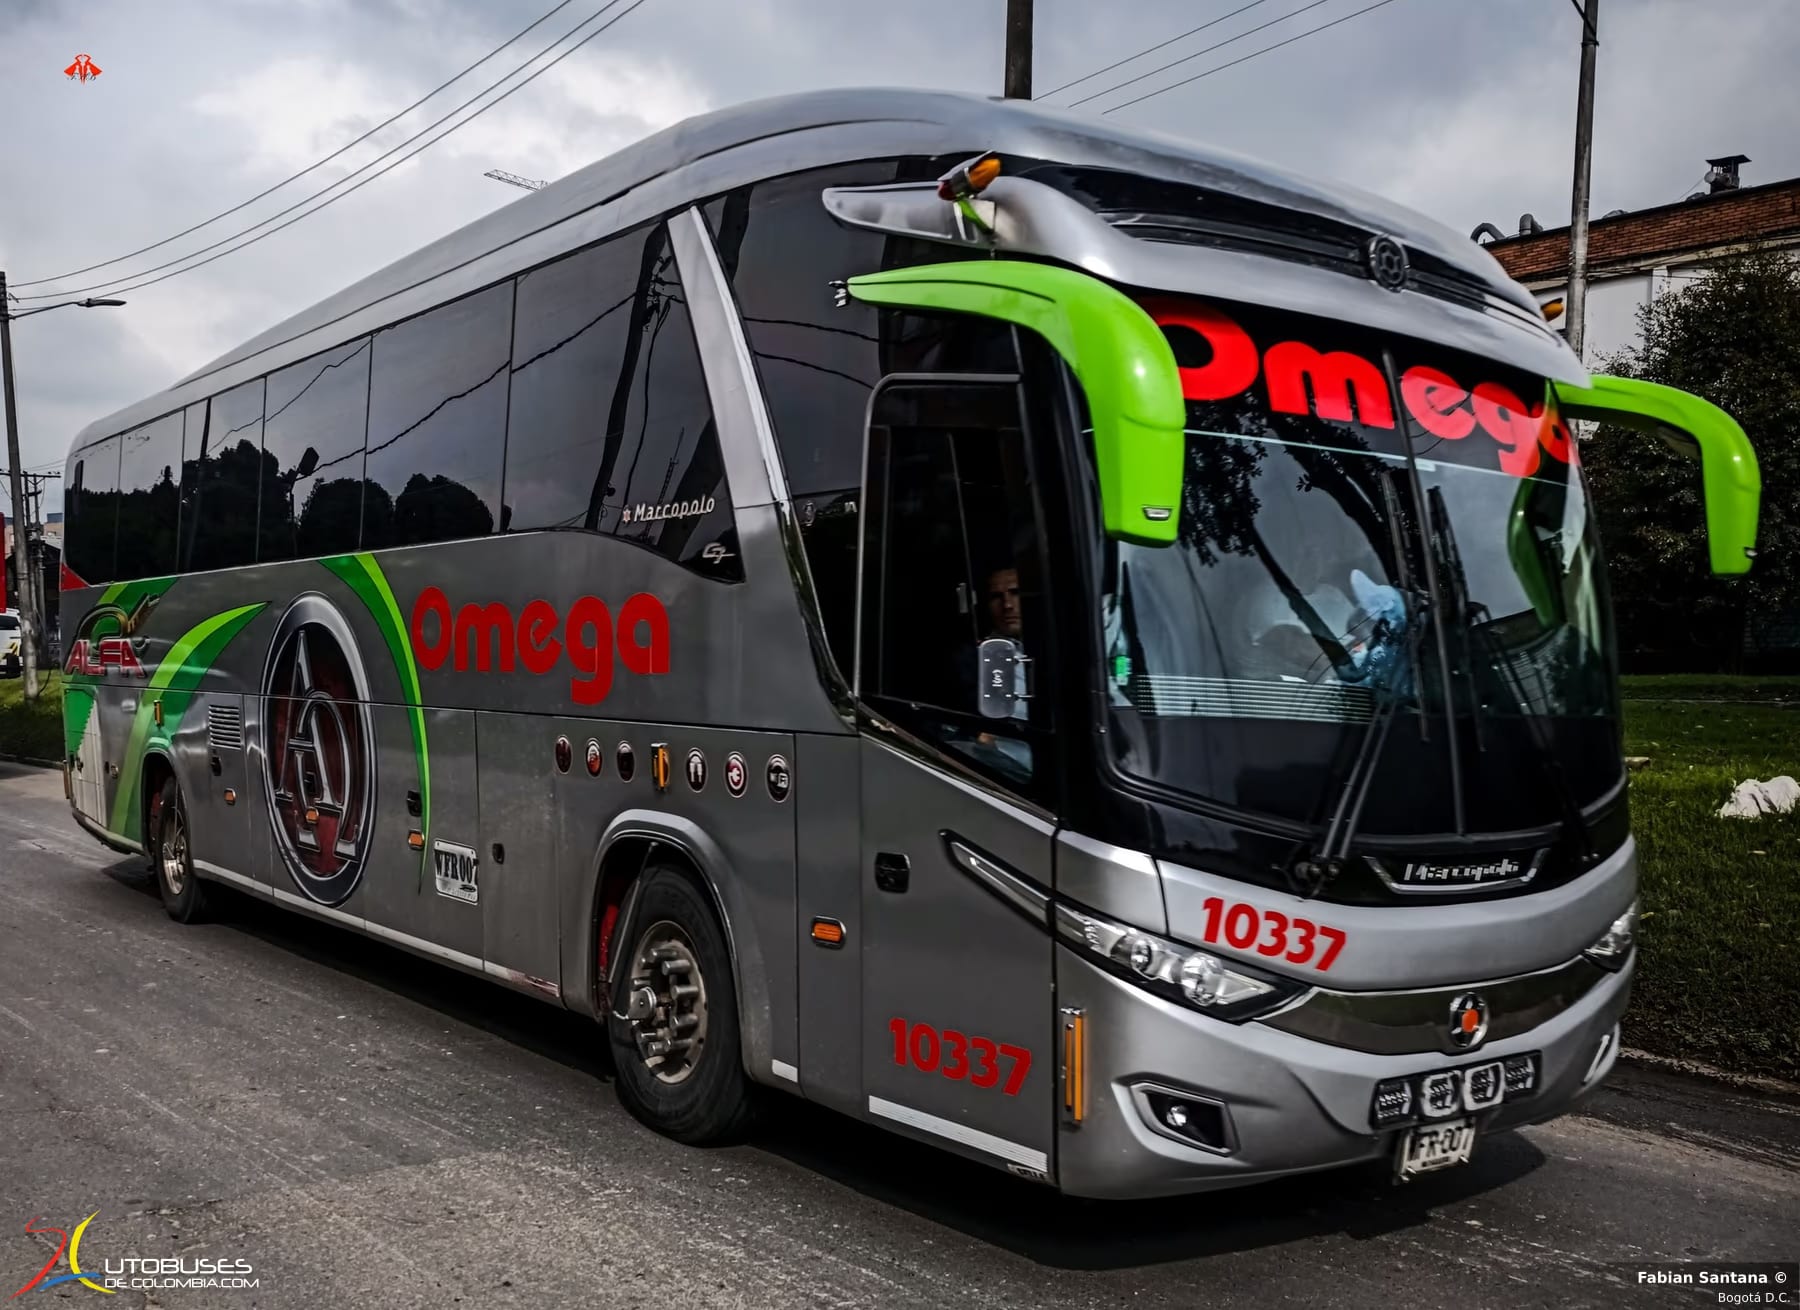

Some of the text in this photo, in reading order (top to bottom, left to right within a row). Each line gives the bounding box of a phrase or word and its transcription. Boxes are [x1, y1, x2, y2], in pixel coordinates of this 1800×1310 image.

[634, 494, 715, 522] Marcopolo
[64, 639, 145, 678] ALFA
[411, 586, 671, 706] Omega
[1202, 897, 1346, 972] 10337
[889, 1017, 1032, 1096] 10337
